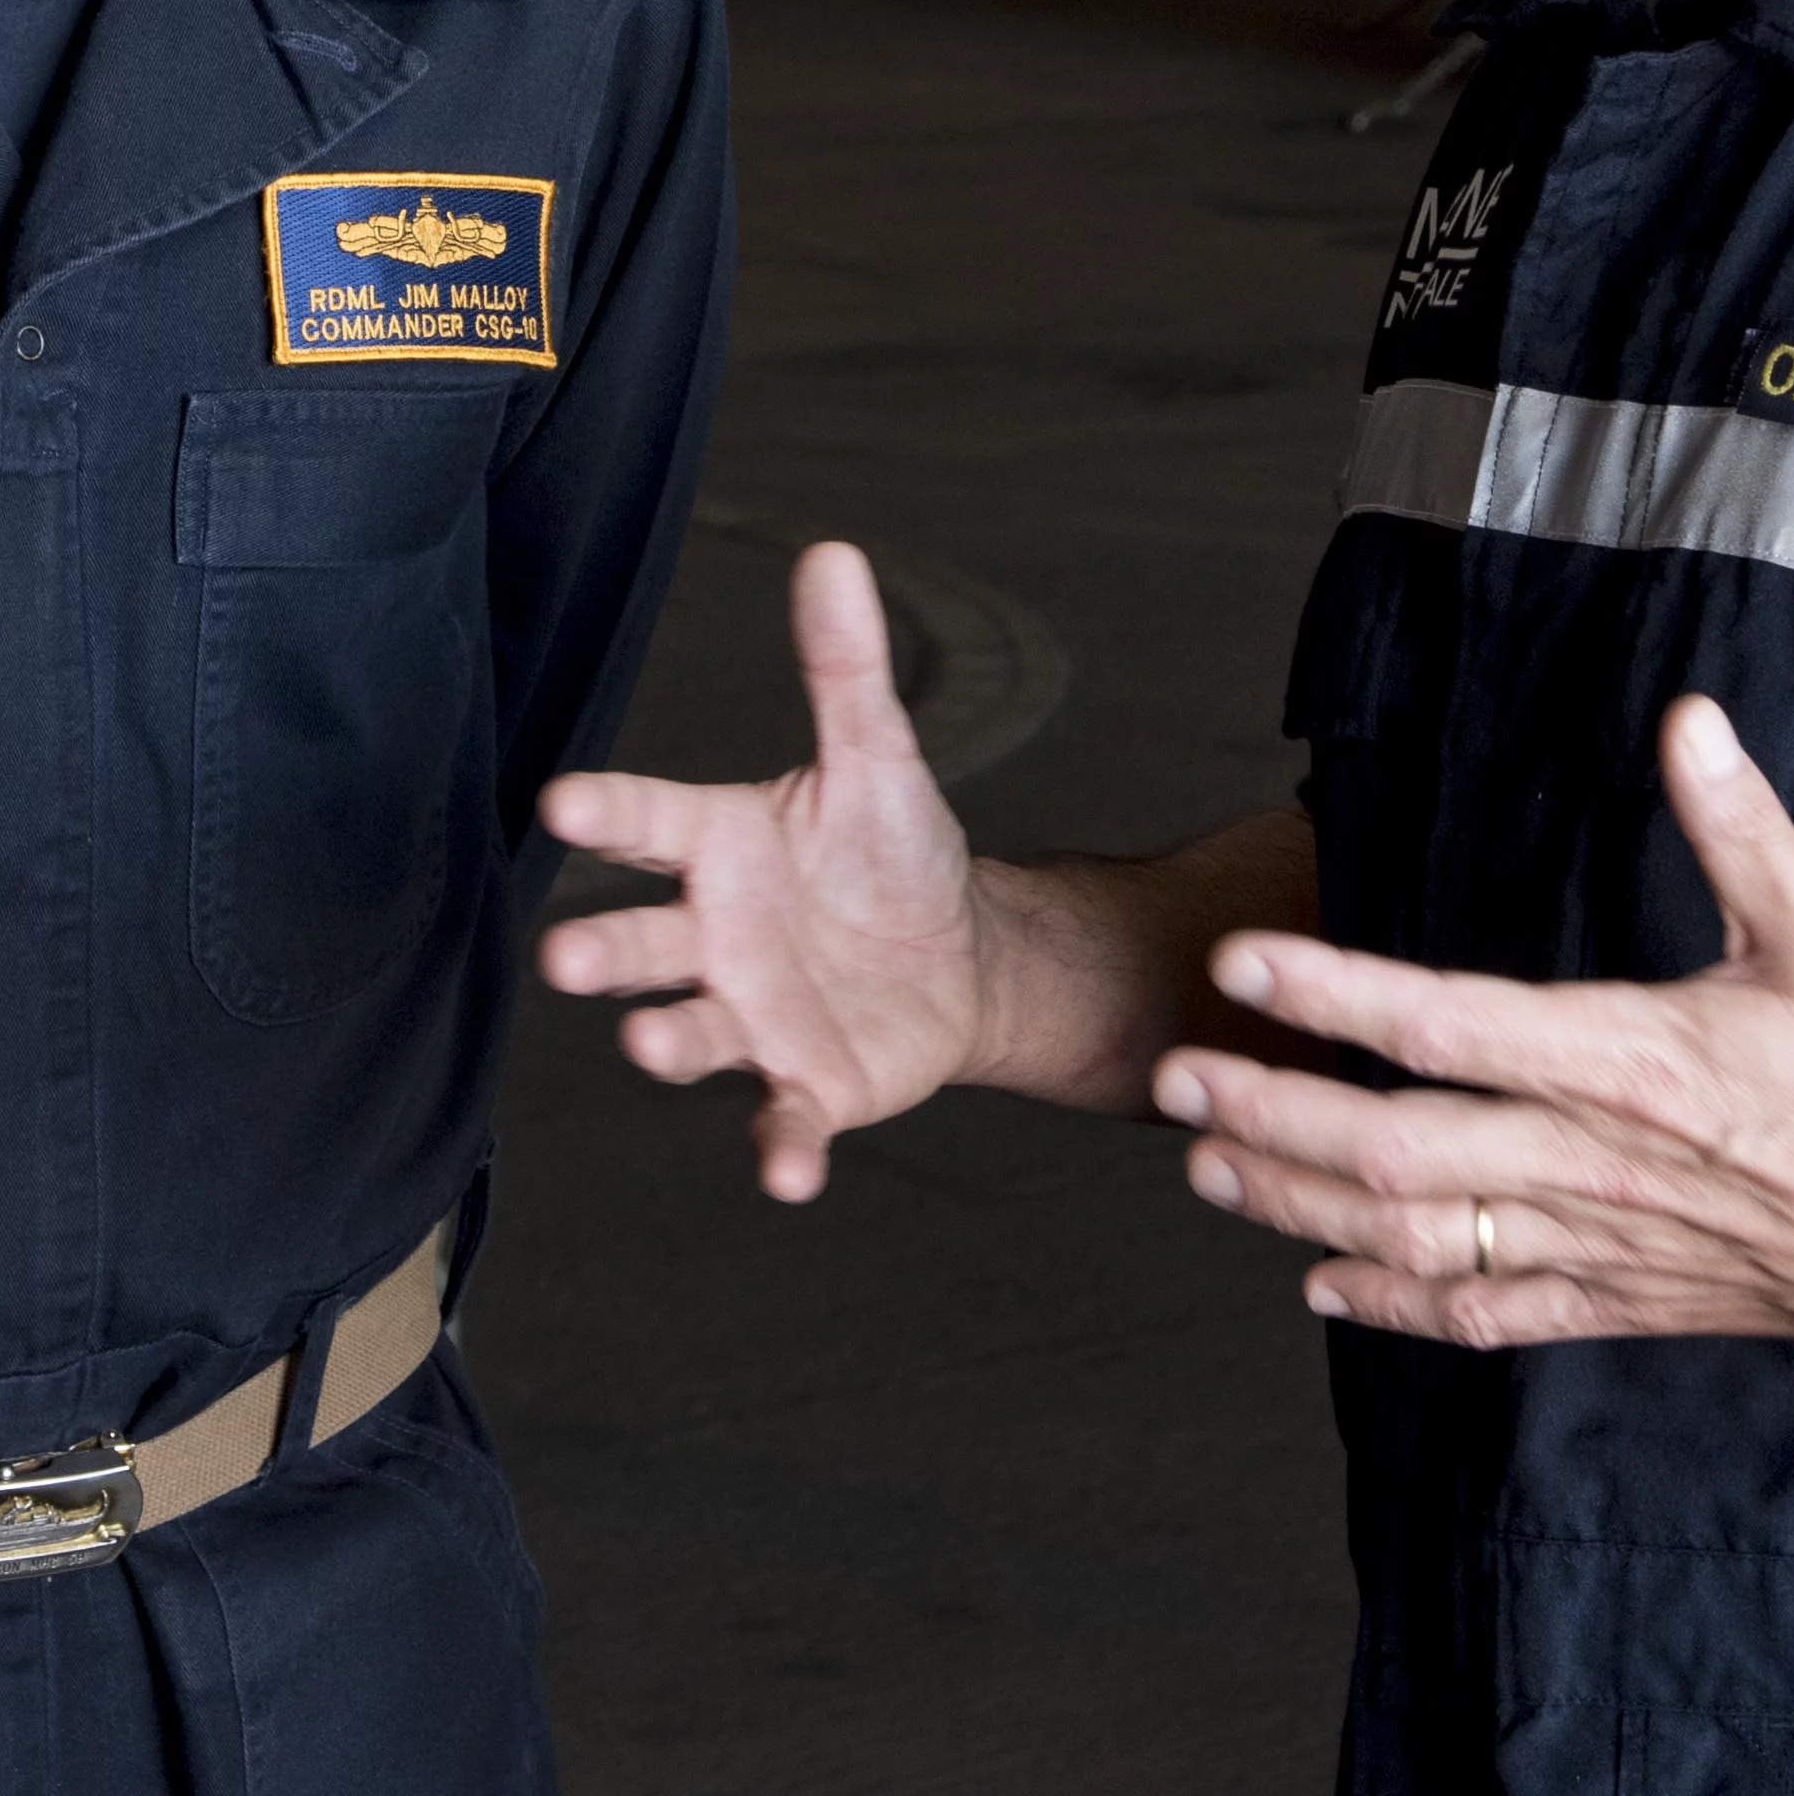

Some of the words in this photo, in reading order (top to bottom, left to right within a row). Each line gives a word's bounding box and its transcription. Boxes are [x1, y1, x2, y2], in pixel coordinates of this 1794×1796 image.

[309, 284, 386, 313] RDML
[398, 283, 440, 310] JIM
[451, 284, 528, 311] MALLOY
[300, 313, 464, 342] COMMANDER
[474, 315, 538, 341] CSG-10
